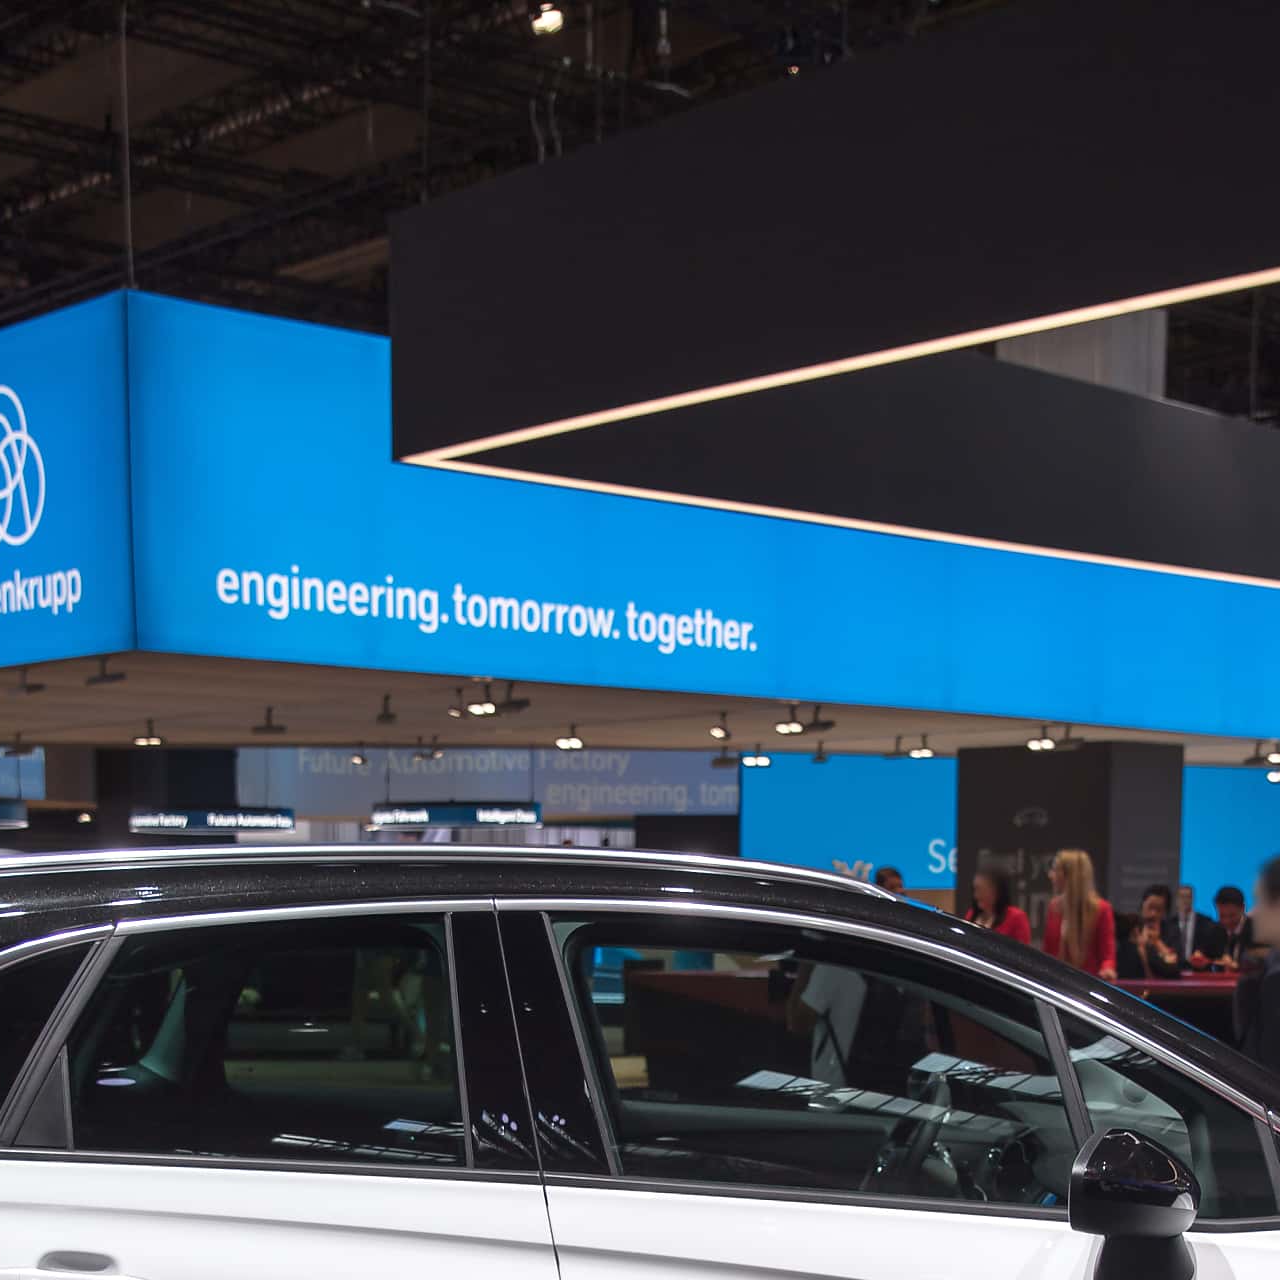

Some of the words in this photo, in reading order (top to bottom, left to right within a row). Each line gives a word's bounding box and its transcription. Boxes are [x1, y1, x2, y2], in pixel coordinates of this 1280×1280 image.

[215, 564, 448, 634] engineering.
[452, 583, 620, 640] tomorrow.
[625, 602, 758, 655] together.
[298, 750, 371, 776] Future
[385, 750, 530, 776] Automotive
